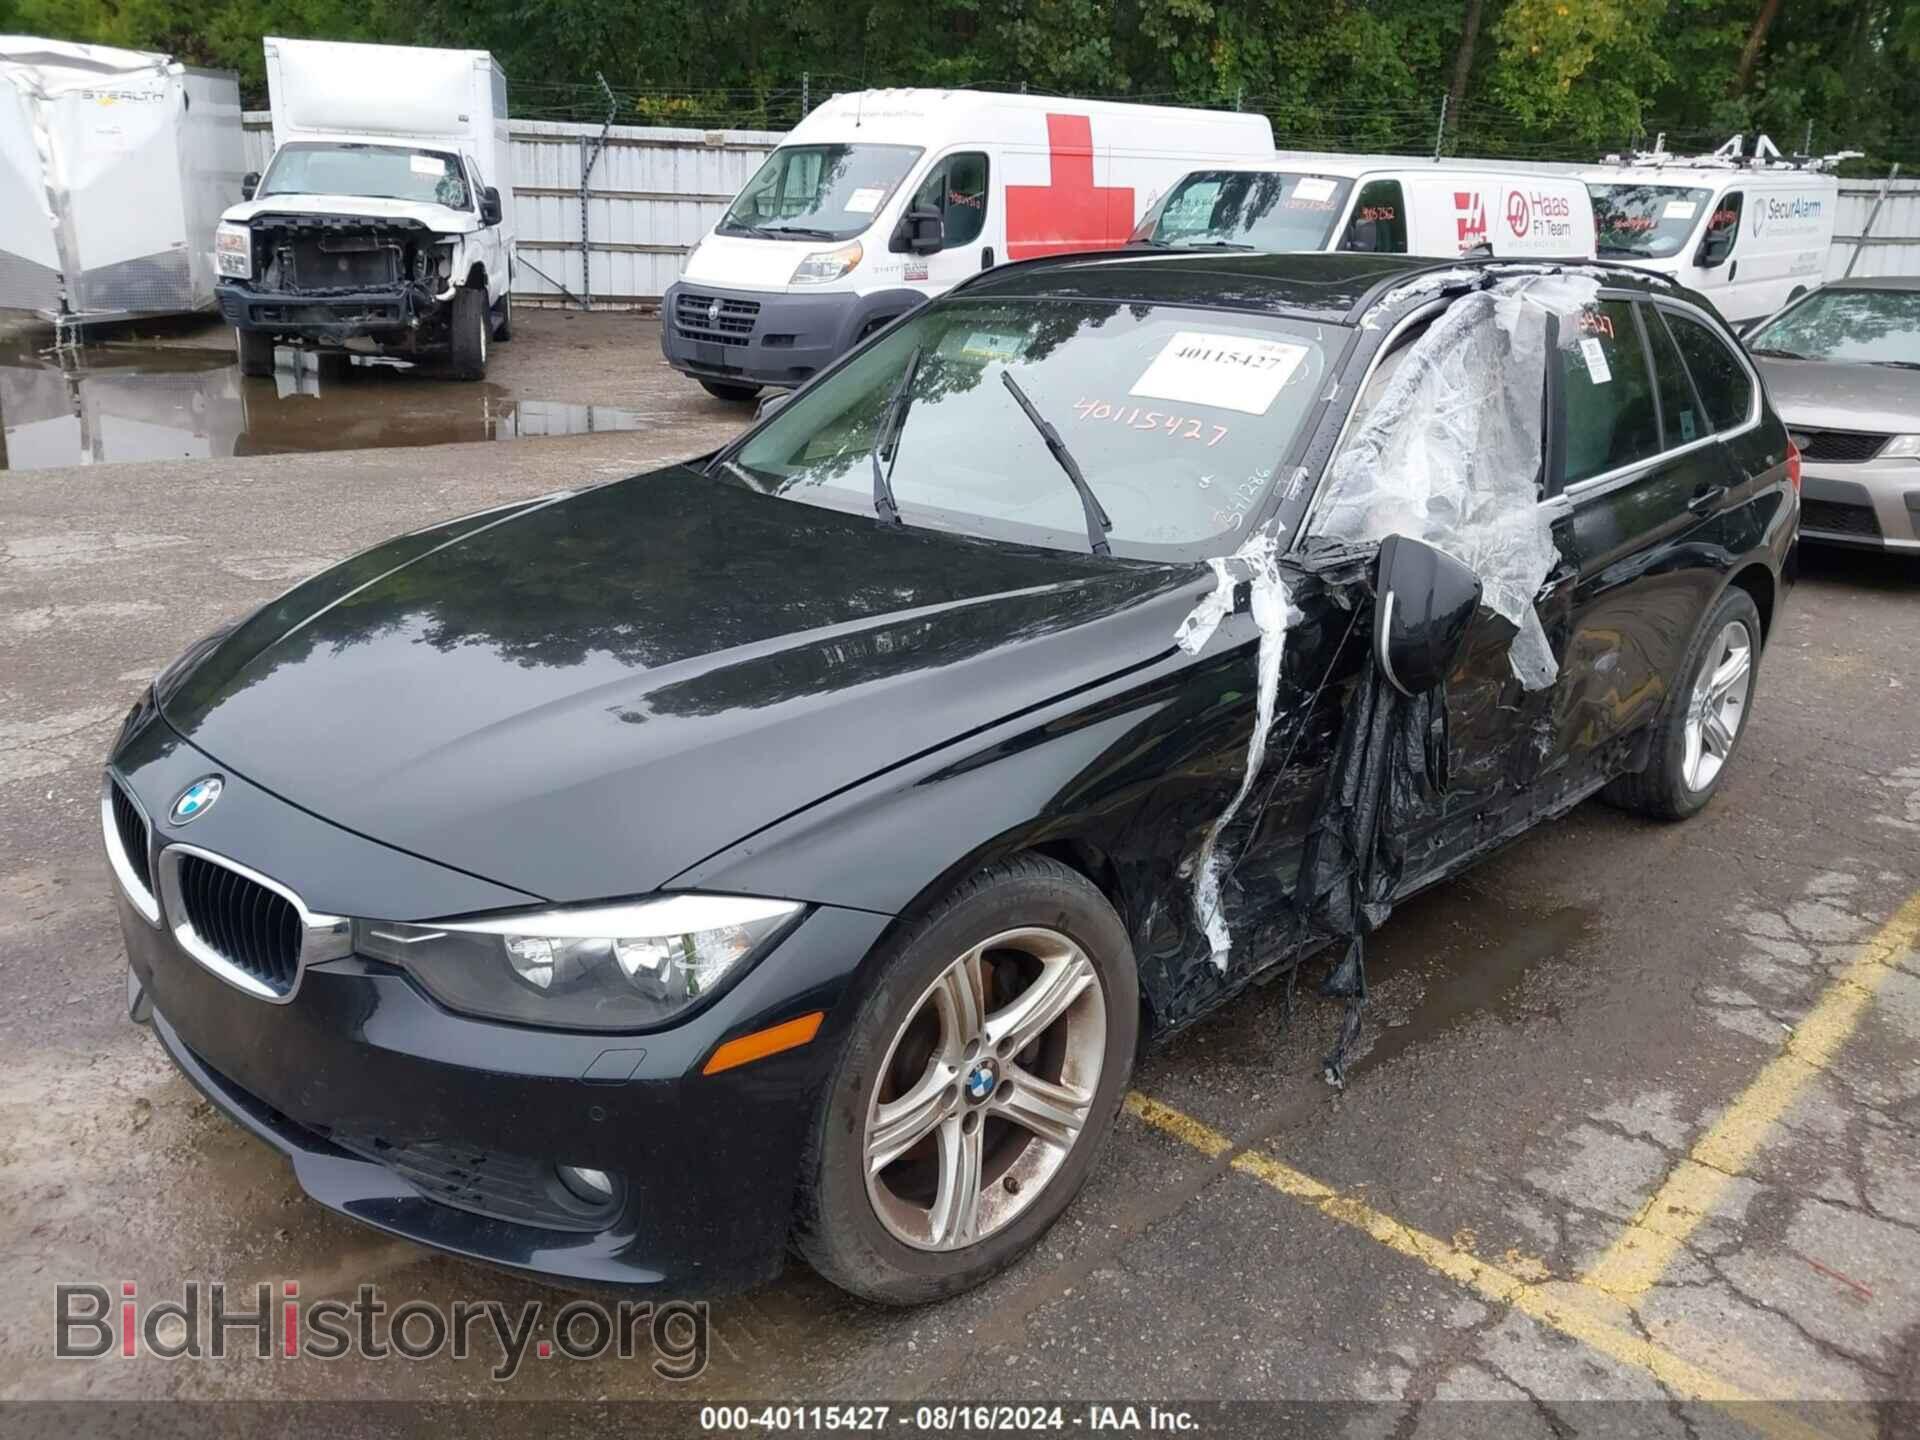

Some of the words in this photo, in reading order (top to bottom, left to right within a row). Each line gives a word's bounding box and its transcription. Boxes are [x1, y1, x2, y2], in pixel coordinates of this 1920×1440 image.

[1530, 191, 1570, 217] Haas
[1767, 197, 1823, 219] SecurAlarm
[1533, 219, 1544, 235] F1
[1547, 220, 1571, 236] Team
[1177, 346, 1281, 369] 40115427
[1073, 397, 1228, 446] 40115427
